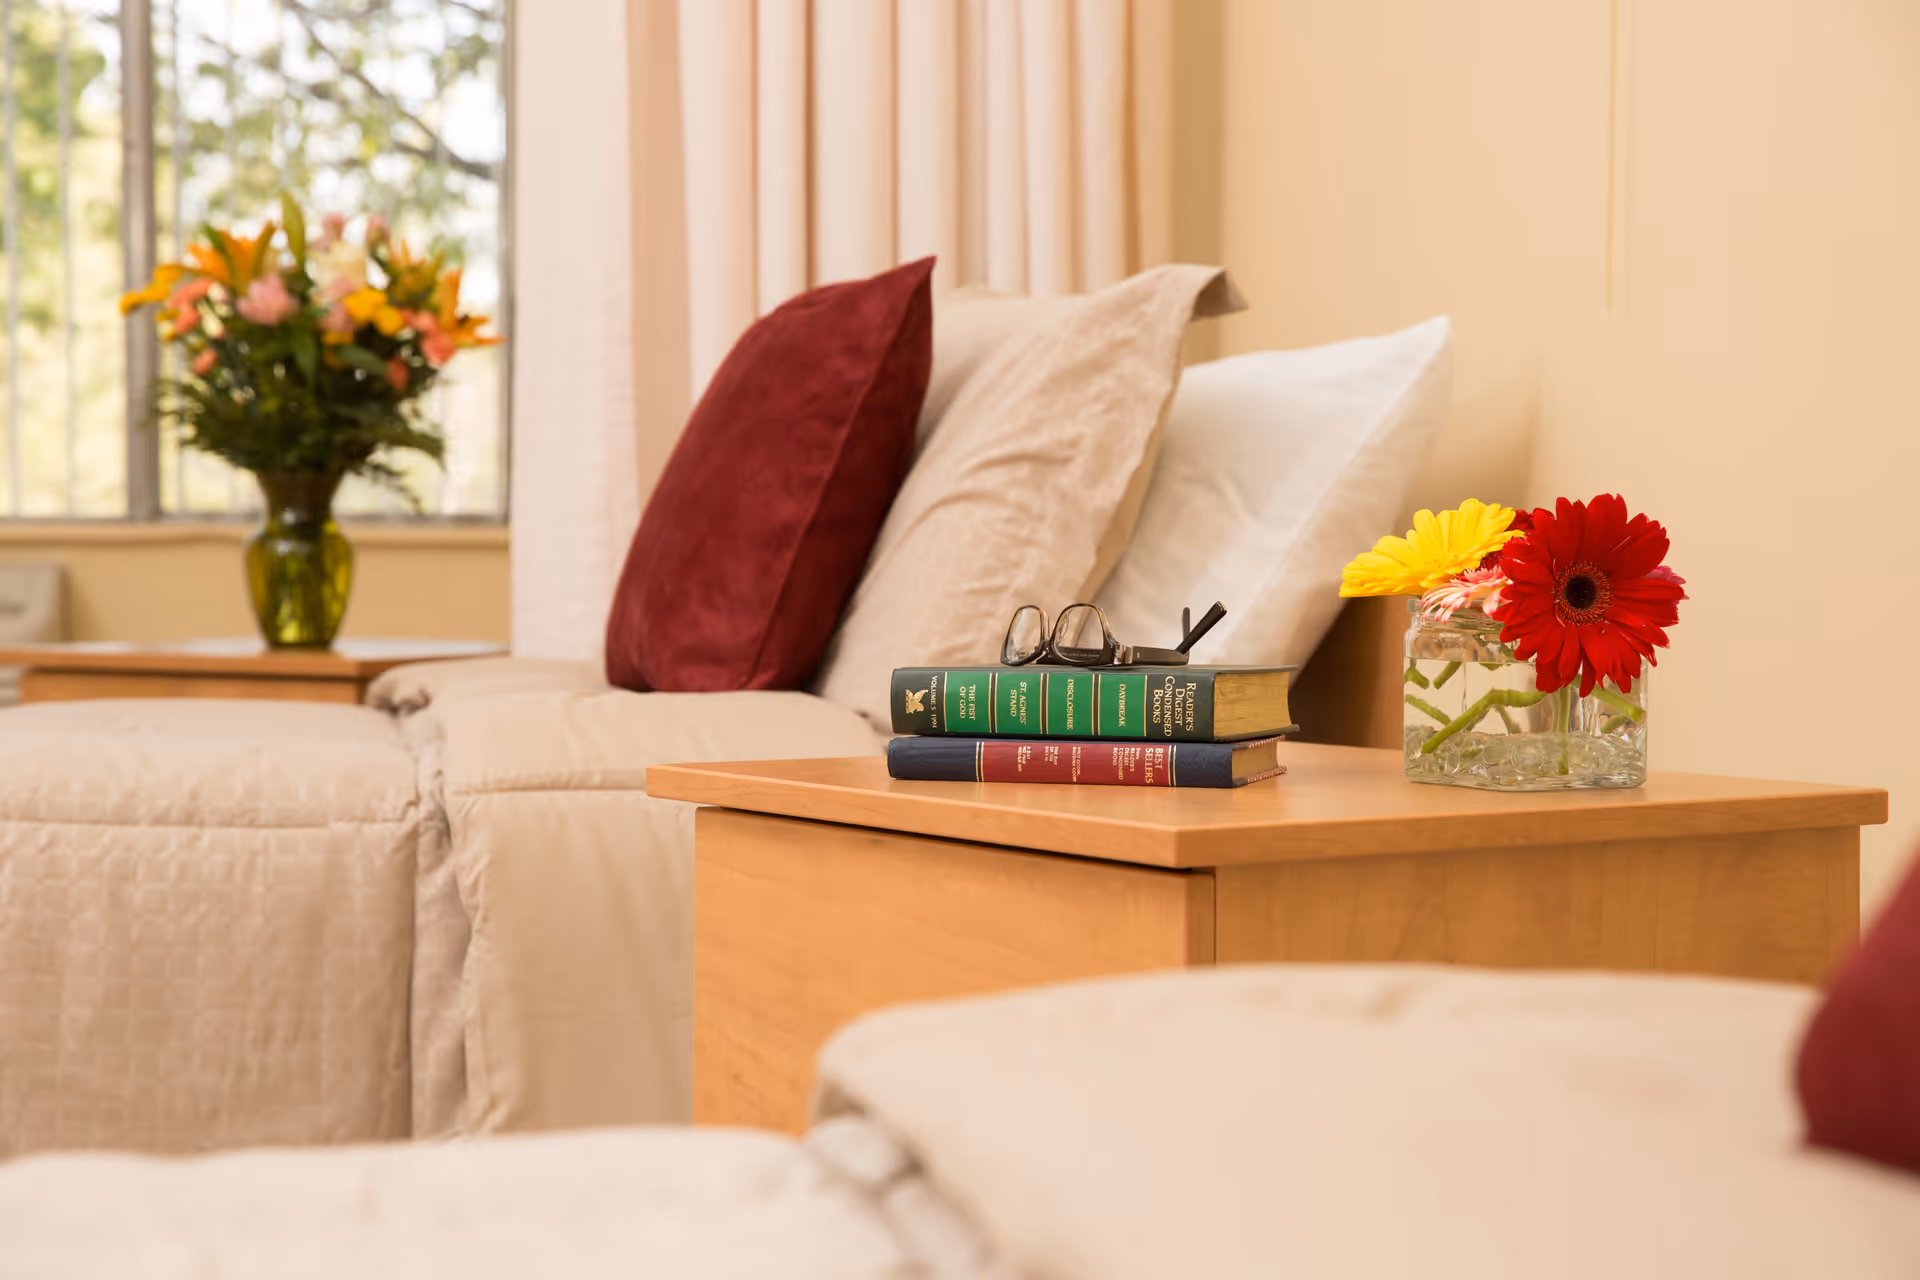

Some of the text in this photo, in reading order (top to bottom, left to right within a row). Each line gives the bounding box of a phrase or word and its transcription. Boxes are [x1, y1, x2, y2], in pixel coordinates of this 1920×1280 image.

[960, 686, 966, 698] OF
[1153, 689, 1164, 724] BOOKS
[1164, 676, 1176, 737] CONDENSED
[1175, 688, 1186, 726] DIGEST
[1186, 682, 1197, 731] READER'S
[1145, 748, 1154, 784] SELLERS
[1154, 748, 1164, 770] BEST
